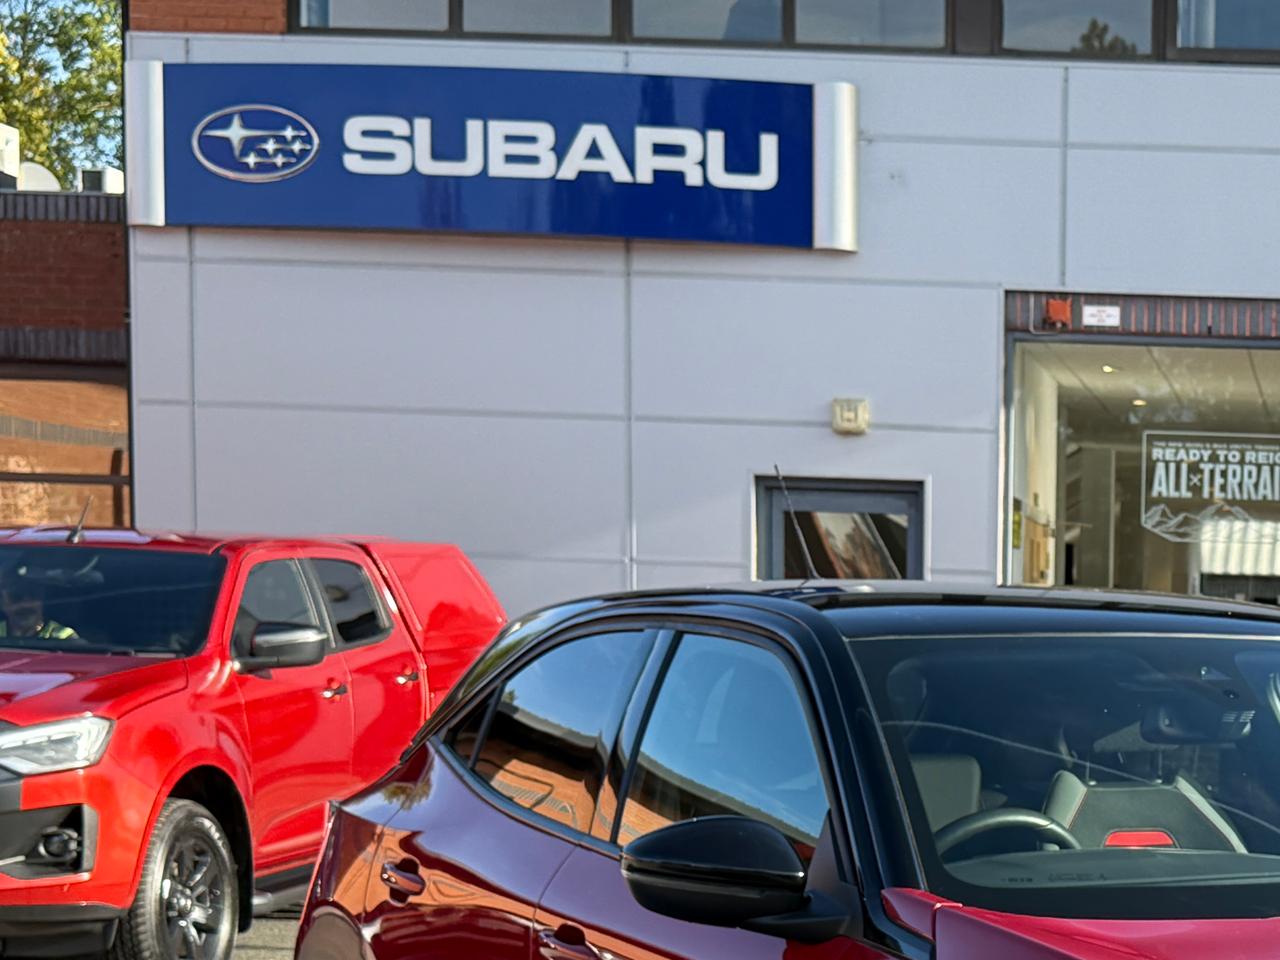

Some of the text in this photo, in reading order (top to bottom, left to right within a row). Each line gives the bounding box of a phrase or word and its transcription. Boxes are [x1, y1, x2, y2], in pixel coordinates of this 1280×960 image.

[342, 115, 779, 191] SUBARU
[1151, 447, 1213, 462] READY
[1216, 449, 1242, 463] TO
